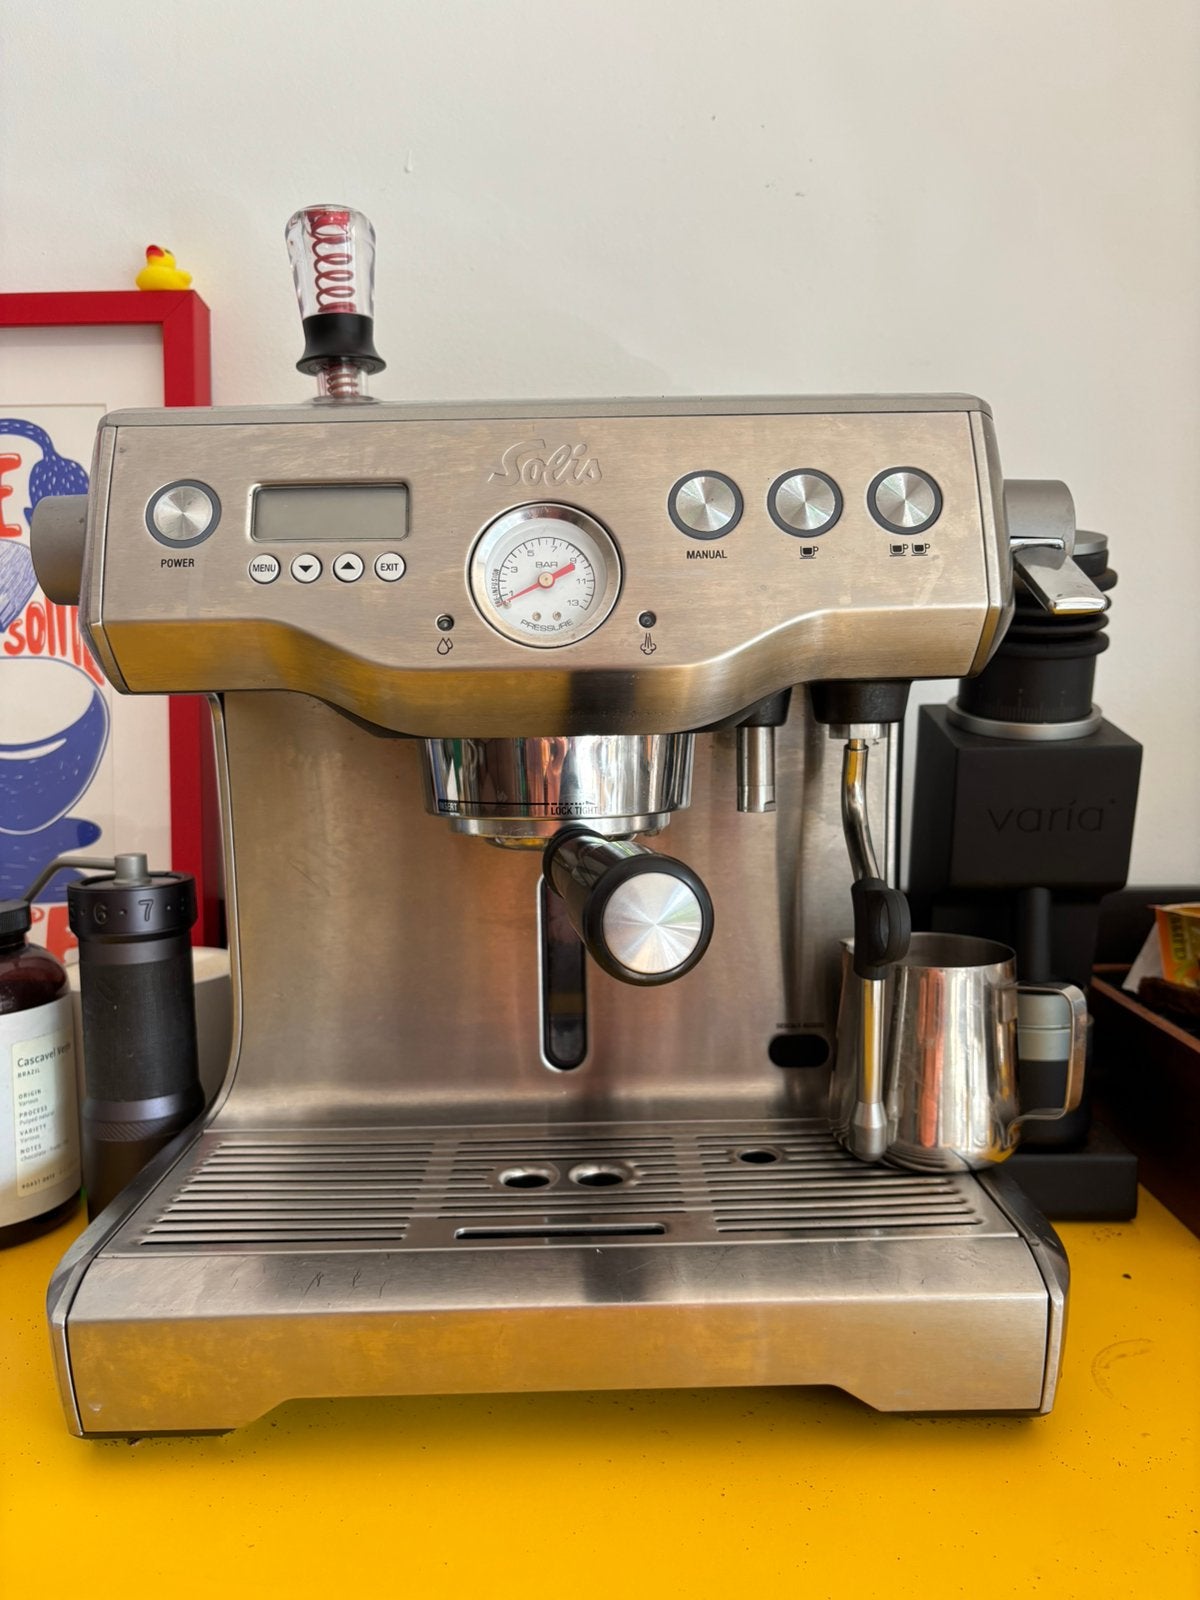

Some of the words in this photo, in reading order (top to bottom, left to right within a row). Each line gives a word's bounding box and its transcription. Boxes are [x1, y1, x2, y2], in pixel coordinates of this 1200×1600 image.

[488, 439, 602, 487] Solis
[686, 550, 728, 559] MANUAL
[161, 558, 194, 568] POWER
[252, 563, 276, 572] MENU
[380, 562, 399, 572] EXIT
[520, 618, 574, 632] PRESSURE
[551, 806, 573, 815] LOCK
[575, 805, 598, 815] TIGHT
[94, 903, 107, 924] 6
[138, 899, 154, 921] 7
[17, 1047, 56, 1068] Cascavel
[17, 1068, 40, 1078] BRAZIL
[18, 1089, 41, 1100] ORIGIN
[19, 1105, 48, 1118] PROCESS
[20, 1123, 46, 1136] VARIETY
[20, 1143, 41, 1155] NOTES
